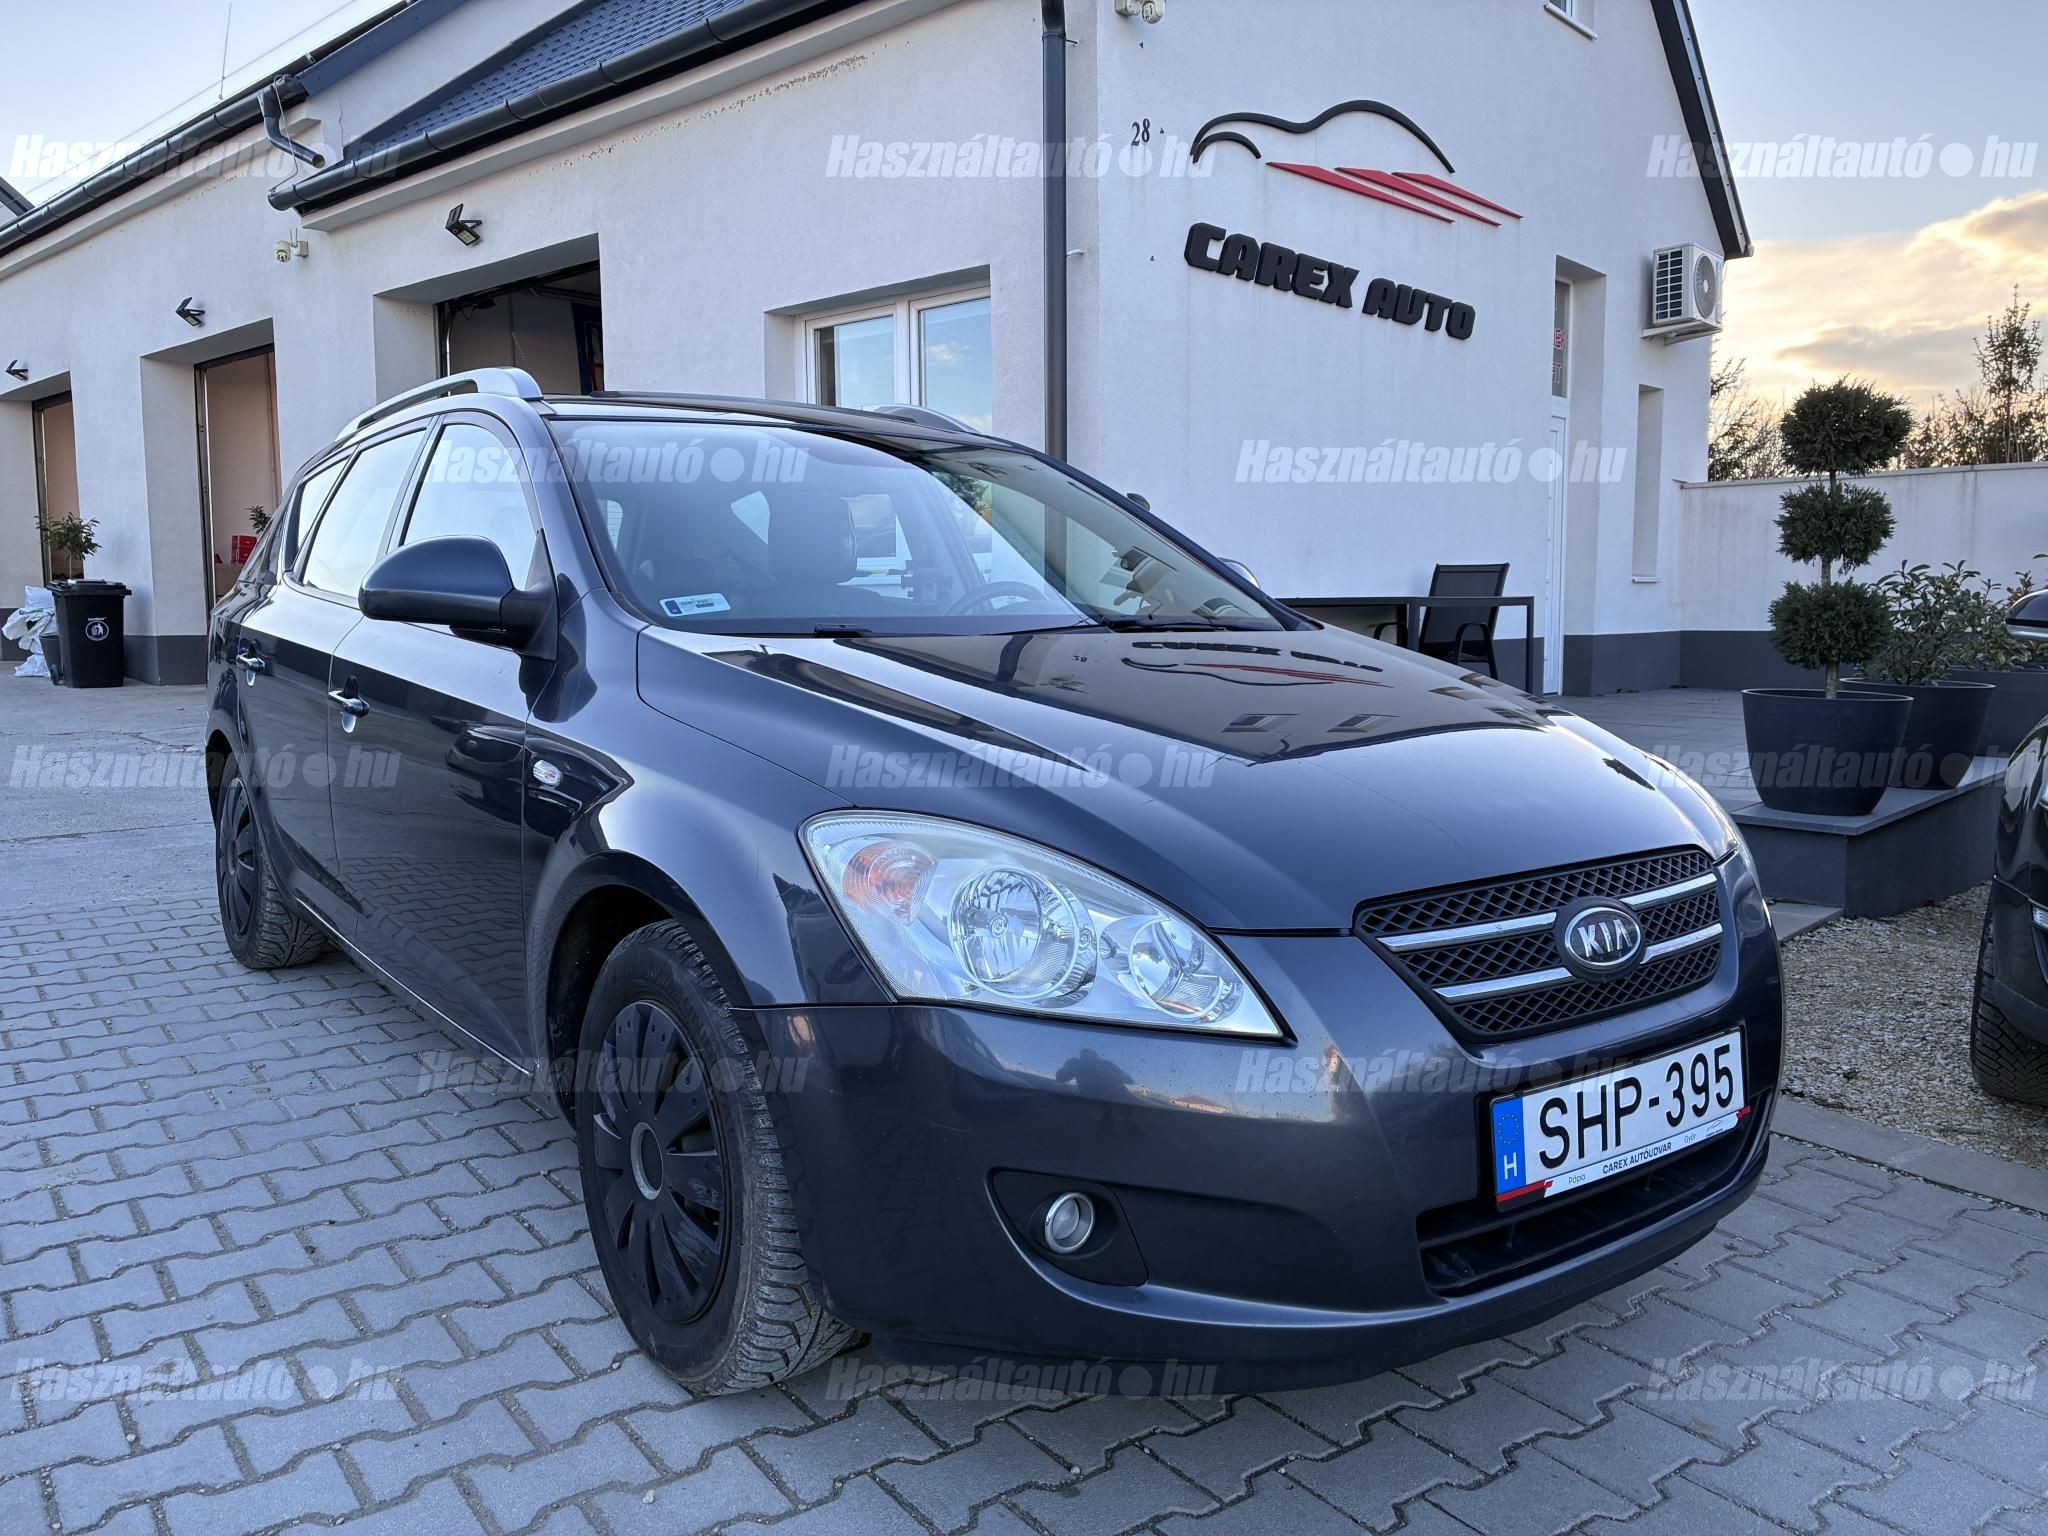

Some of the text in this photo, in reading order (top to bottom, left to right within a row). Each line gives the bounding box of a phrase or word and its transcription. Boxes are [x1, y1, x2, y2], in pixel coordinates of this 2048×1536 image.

[1131, 118, 1150, 147] 28
[1184, 222, 1475, 340] CAREX AUTO
[1577, 919, 1633, 957] KIA
[1538, 1044, 1734, 1169] SHP-395
[1503, 1151, 1518, 1180] H
[1602, 1158, 1628, 1174] CAREX
[1629, 1142, 1672, 1165] AUTÓUDVAR
